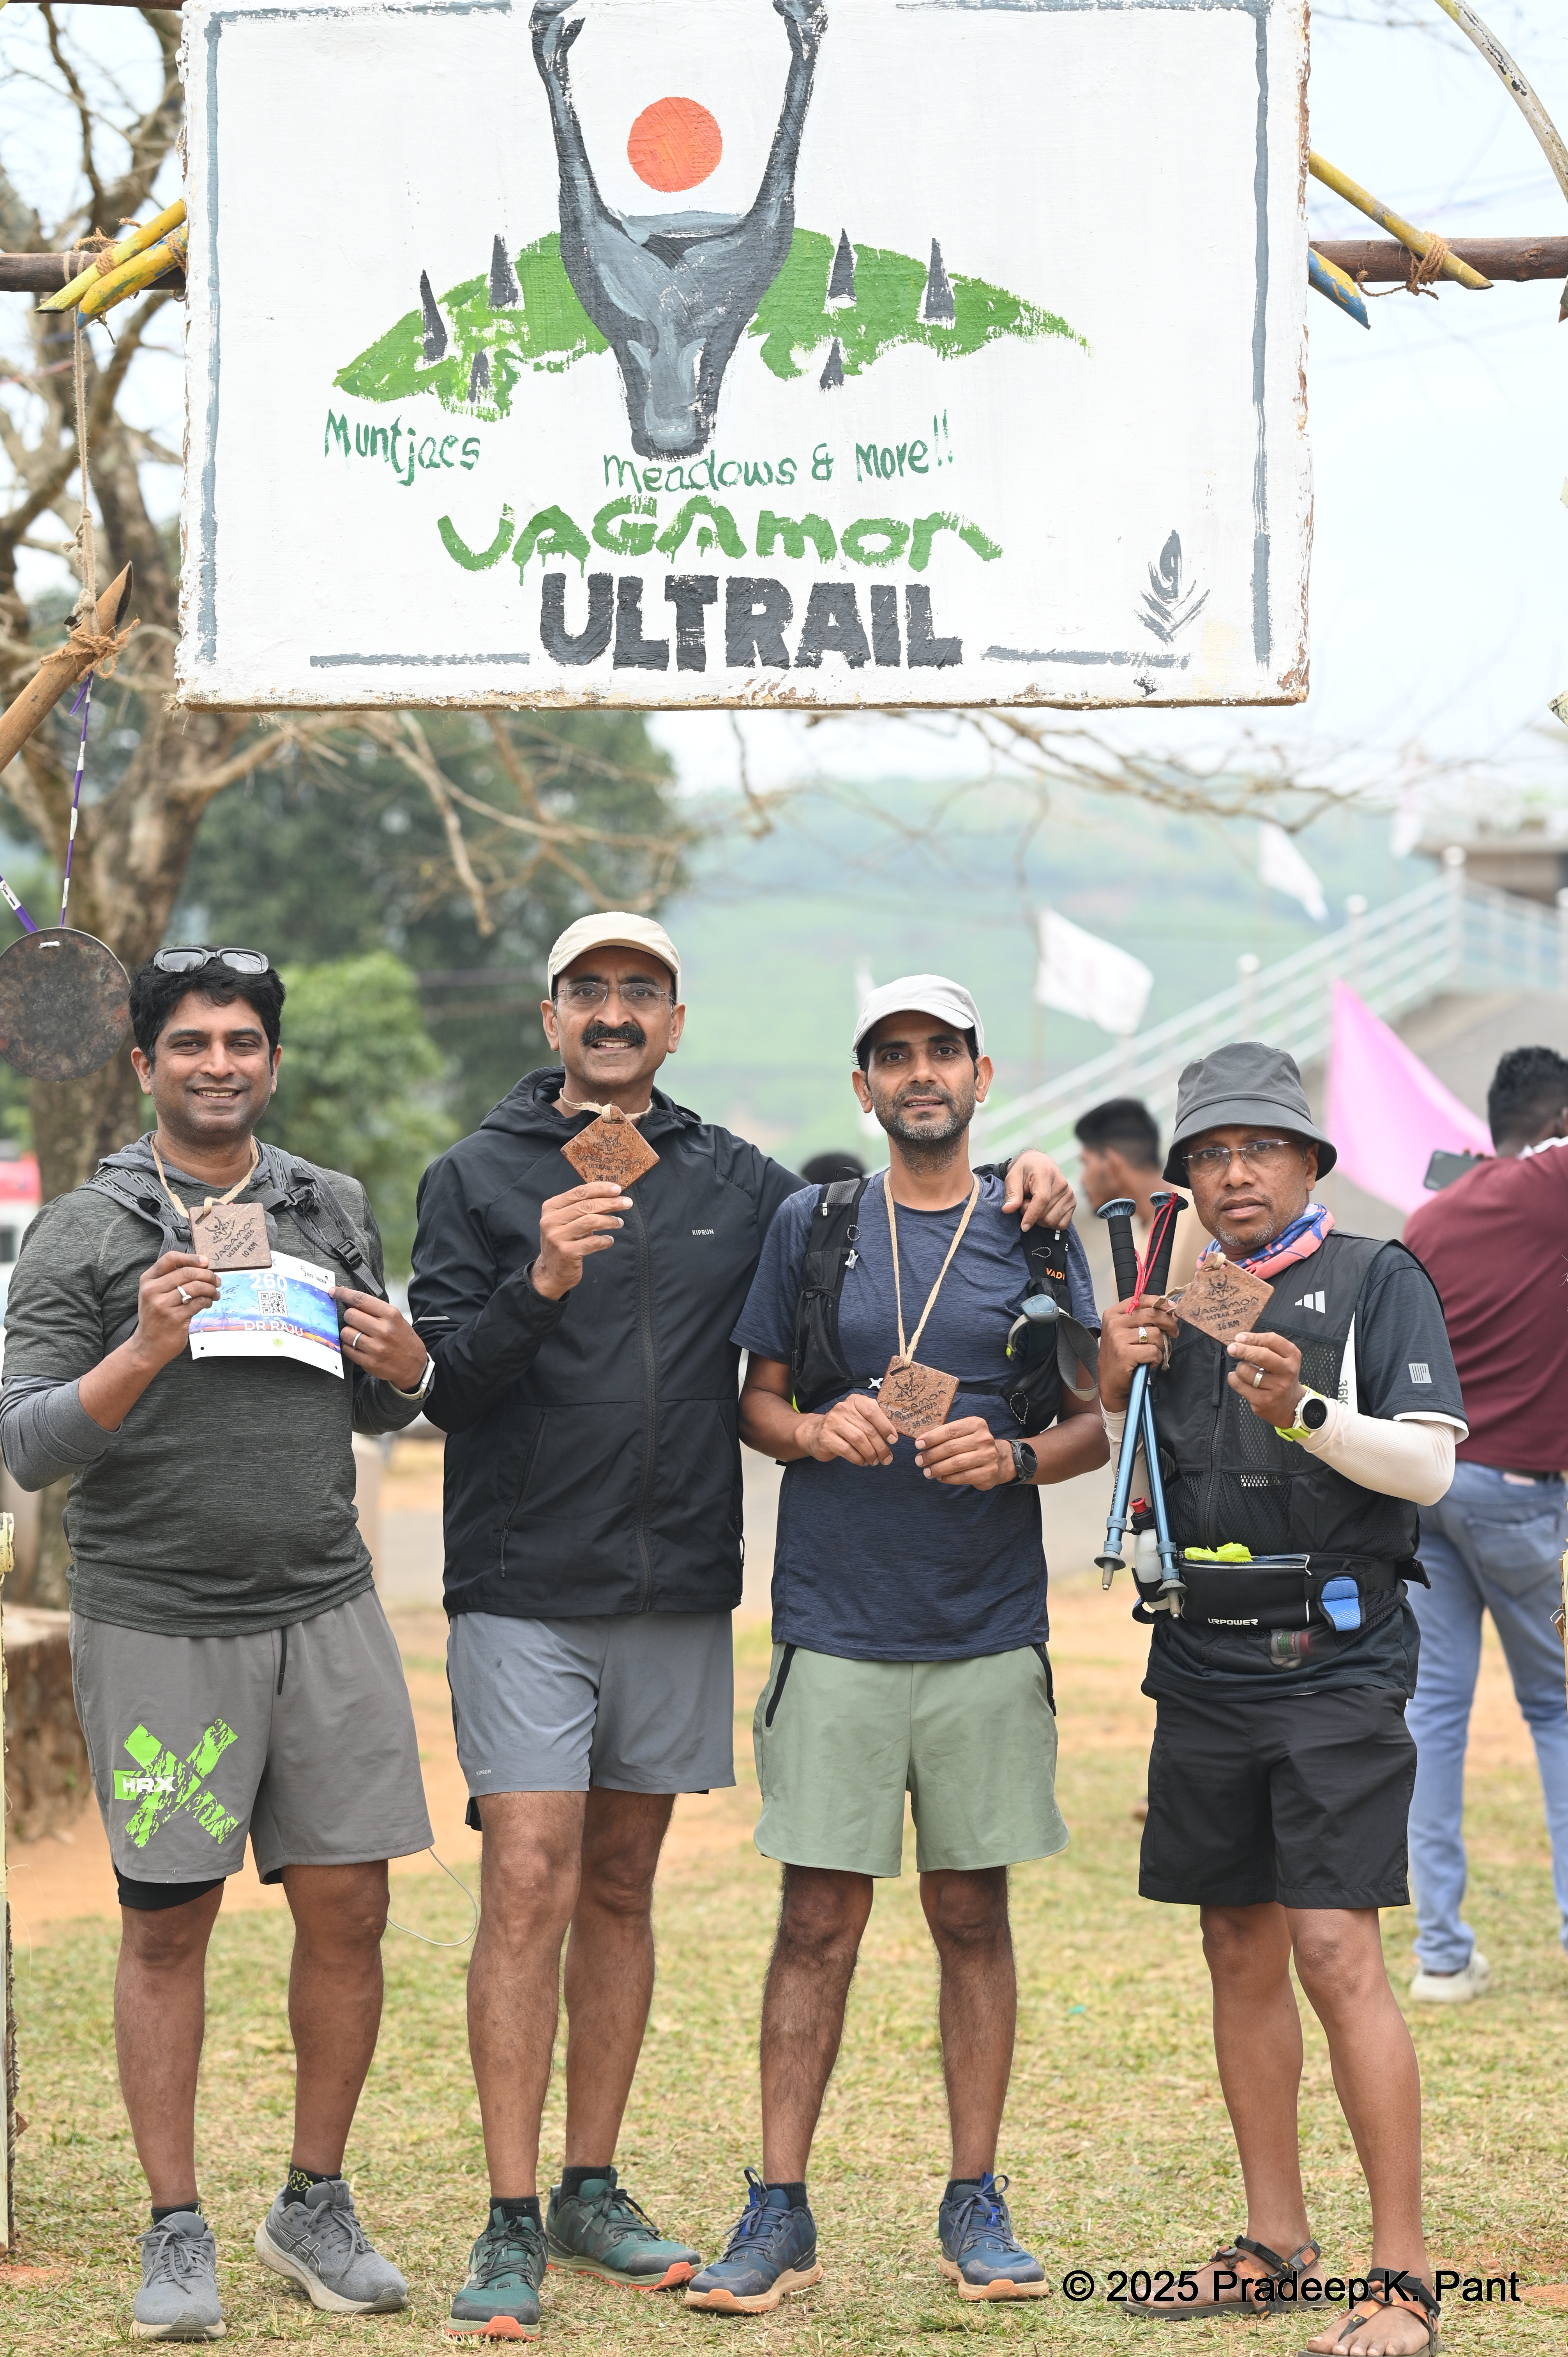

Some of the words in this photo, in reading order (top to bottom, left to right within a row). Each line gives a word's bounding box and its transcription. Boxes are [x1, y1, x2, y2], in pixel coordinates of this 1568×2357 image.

[325, 409, 480, 486] Muntjacs
[812, 442, 833, 481] &
[540, 573, 963, 671] ULTRAIL
[227, 1241, 244, 1258] ULTRAIL
[243, 1229, 254, 1241] 2025
[247, 1242, 258, 1252] KM
[1046, 1267, 1065, 1280] VADI
[249, 1273, 288, 1292] 260
[1207, 1312, 1231, 1321] ULTRAIL
[1228, 1320, 1240, 1328] KM
[244, 1321, 266, 1330] DR
[270, 1321, 303, 1336] RAJU
[923, 1402, 937, 1411] 2025
[921, 1415, 932, 1424] KM
[122, 1776, 176, 1793] HRX
